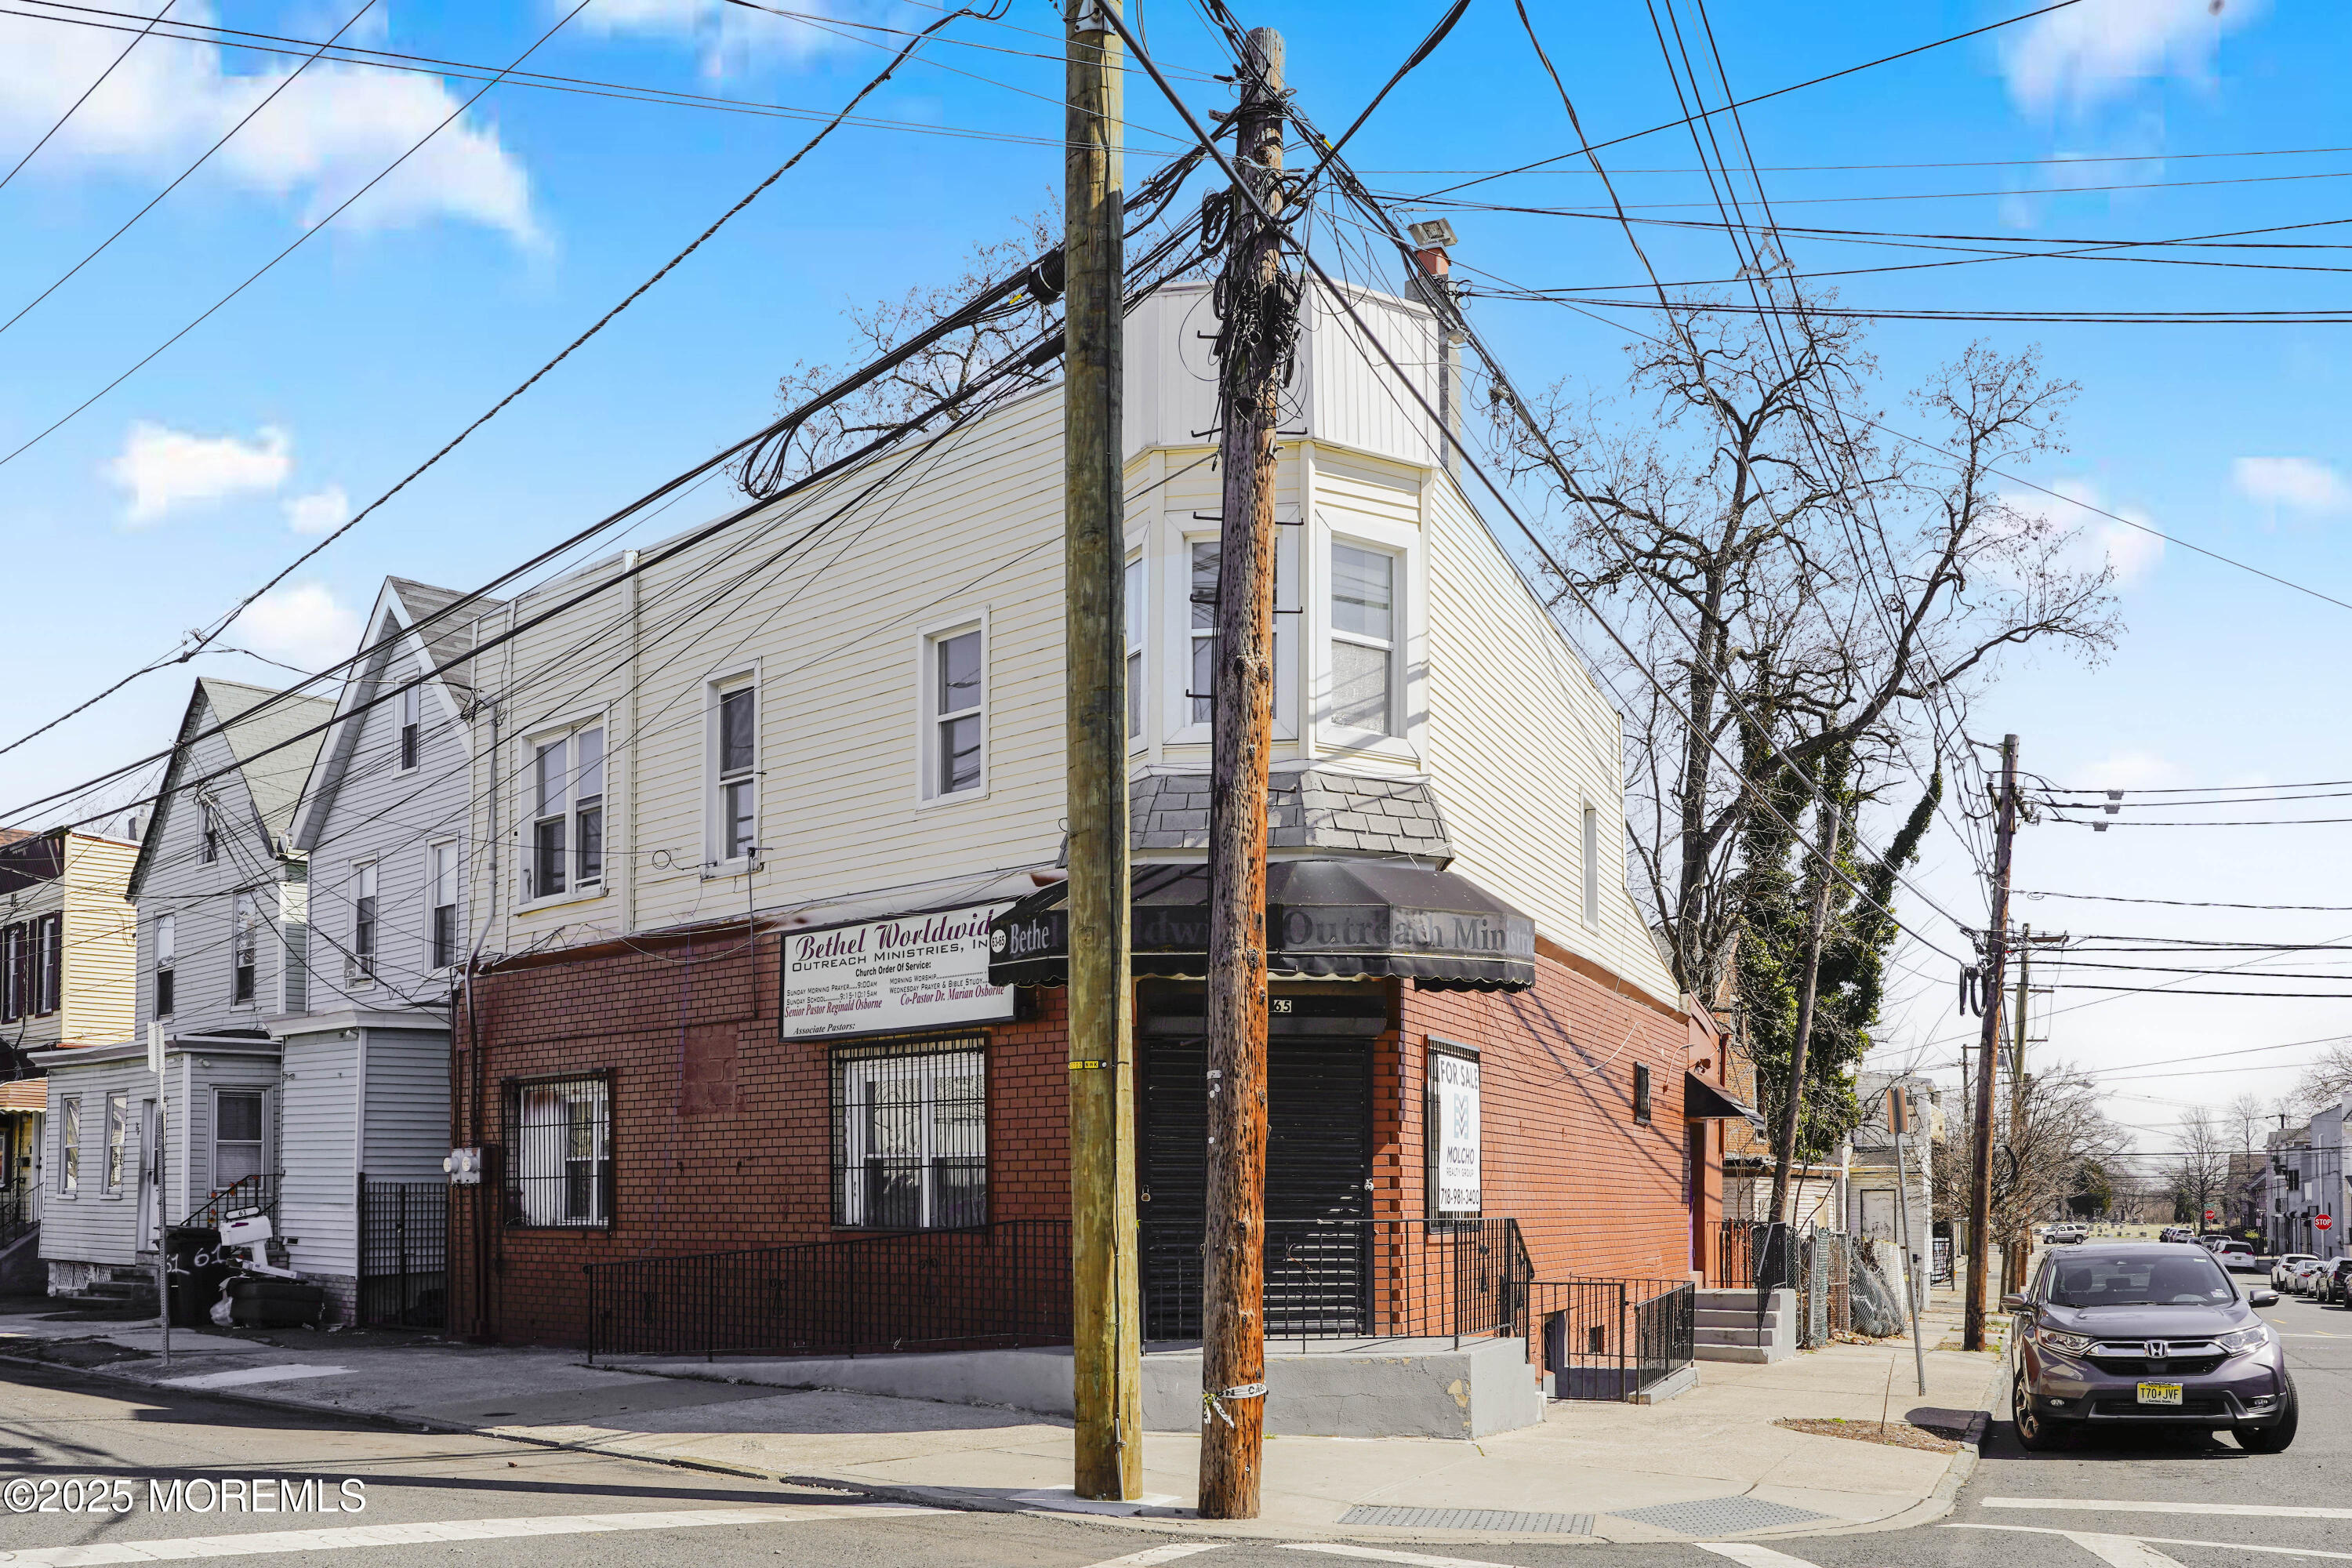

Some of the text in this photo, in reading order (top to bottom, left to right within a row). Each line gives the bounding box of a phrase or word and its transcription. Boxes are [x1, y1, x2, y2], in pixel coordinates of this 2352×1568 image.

[796, 909, 994, 961] Bethel Worldwid
[1283, 910, 1444, 949] Outreach
[992, 935, 1005, 947] 63-65
[792, 939, 988, 972] OUTREACH MINISTRIES, IN
[855, 961, 931, 977] Church Order Of Service:
[901, 985, 1004, 1005] Co-Pastor Dr. Marian Osborne
[785, 998, 883, 1018] Senior Pastor Reginald Osborne
[1274, 1000, 1290, 1011] 65
[793, 1023, 855, 1035] Associate Pastors:
[1440, 1060, 1478, 1090] FOR SALE
[1446, 1145, 1475, 1164] MOLCHO
[1441, 1188, 1479, 1204] 718-981-3400
[194, 1243, 226, 1267] 61
[2162, 1388, 2180, 1399] JVF
